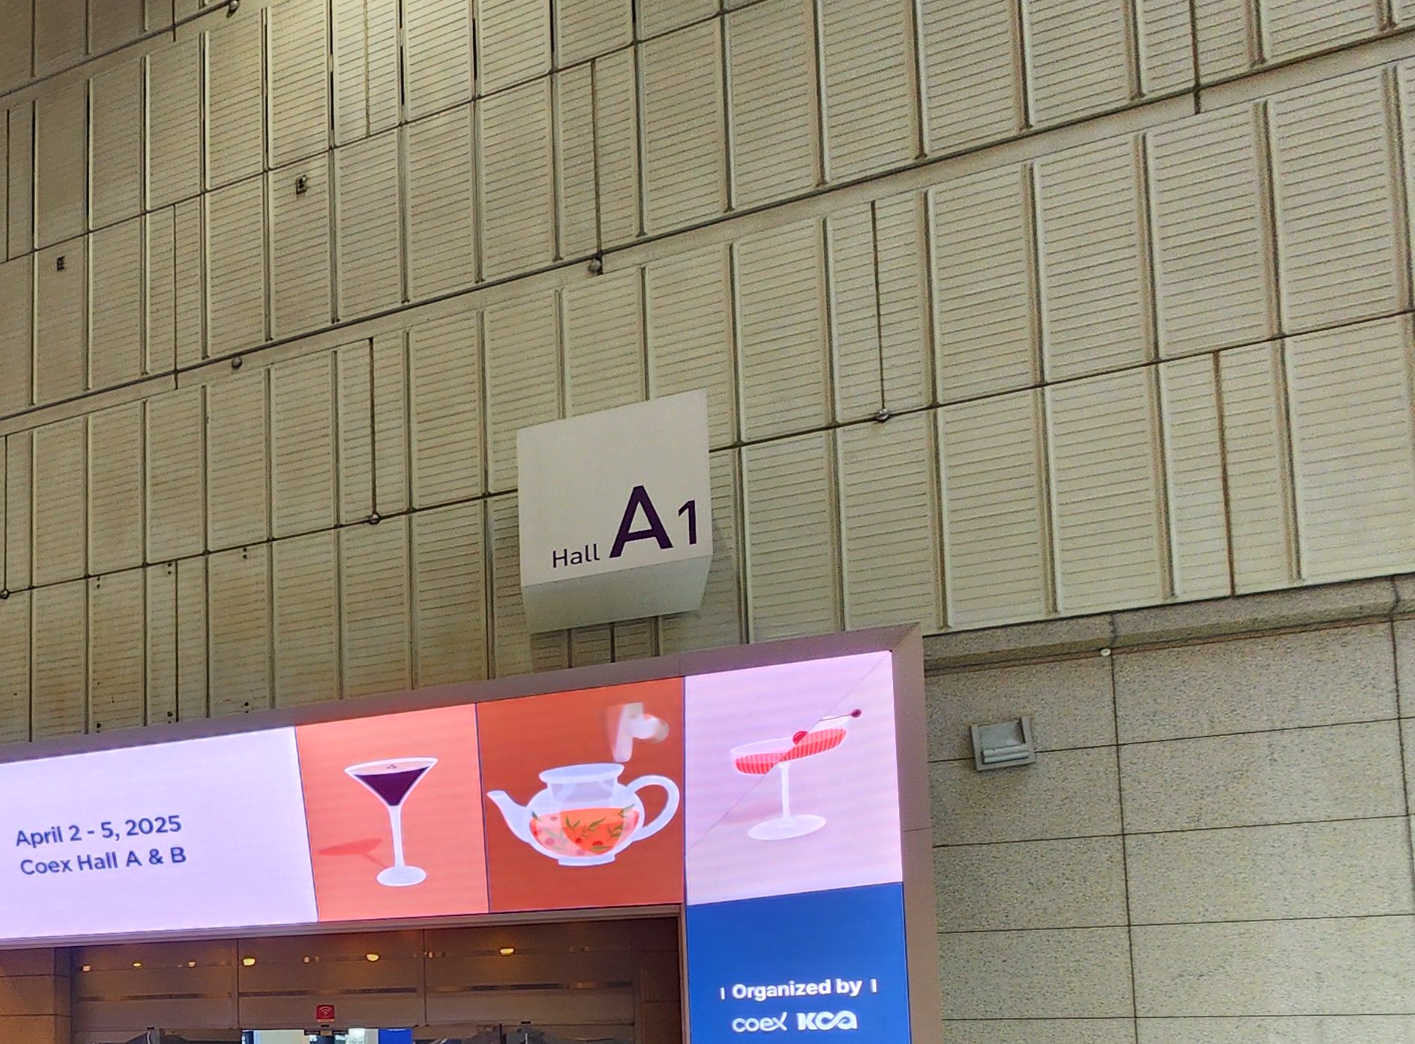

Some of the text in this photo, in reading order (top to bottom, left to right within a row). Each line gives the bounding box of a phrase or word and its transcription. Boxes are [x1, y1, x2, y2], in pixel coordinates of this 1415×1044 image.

[552, 485, 697, 568] Hall A1
[16, 826, 64, 848] April
[68, 824, 82, 842] 2
[100, 821, 120, 842] 5,
[125, 814, 182, 837] 2025
[20, 846, 186, 875] Coex Hall A & B
[732, 978, 862, 1001] Organized by
[731, 1011, 788, 1033] coex
